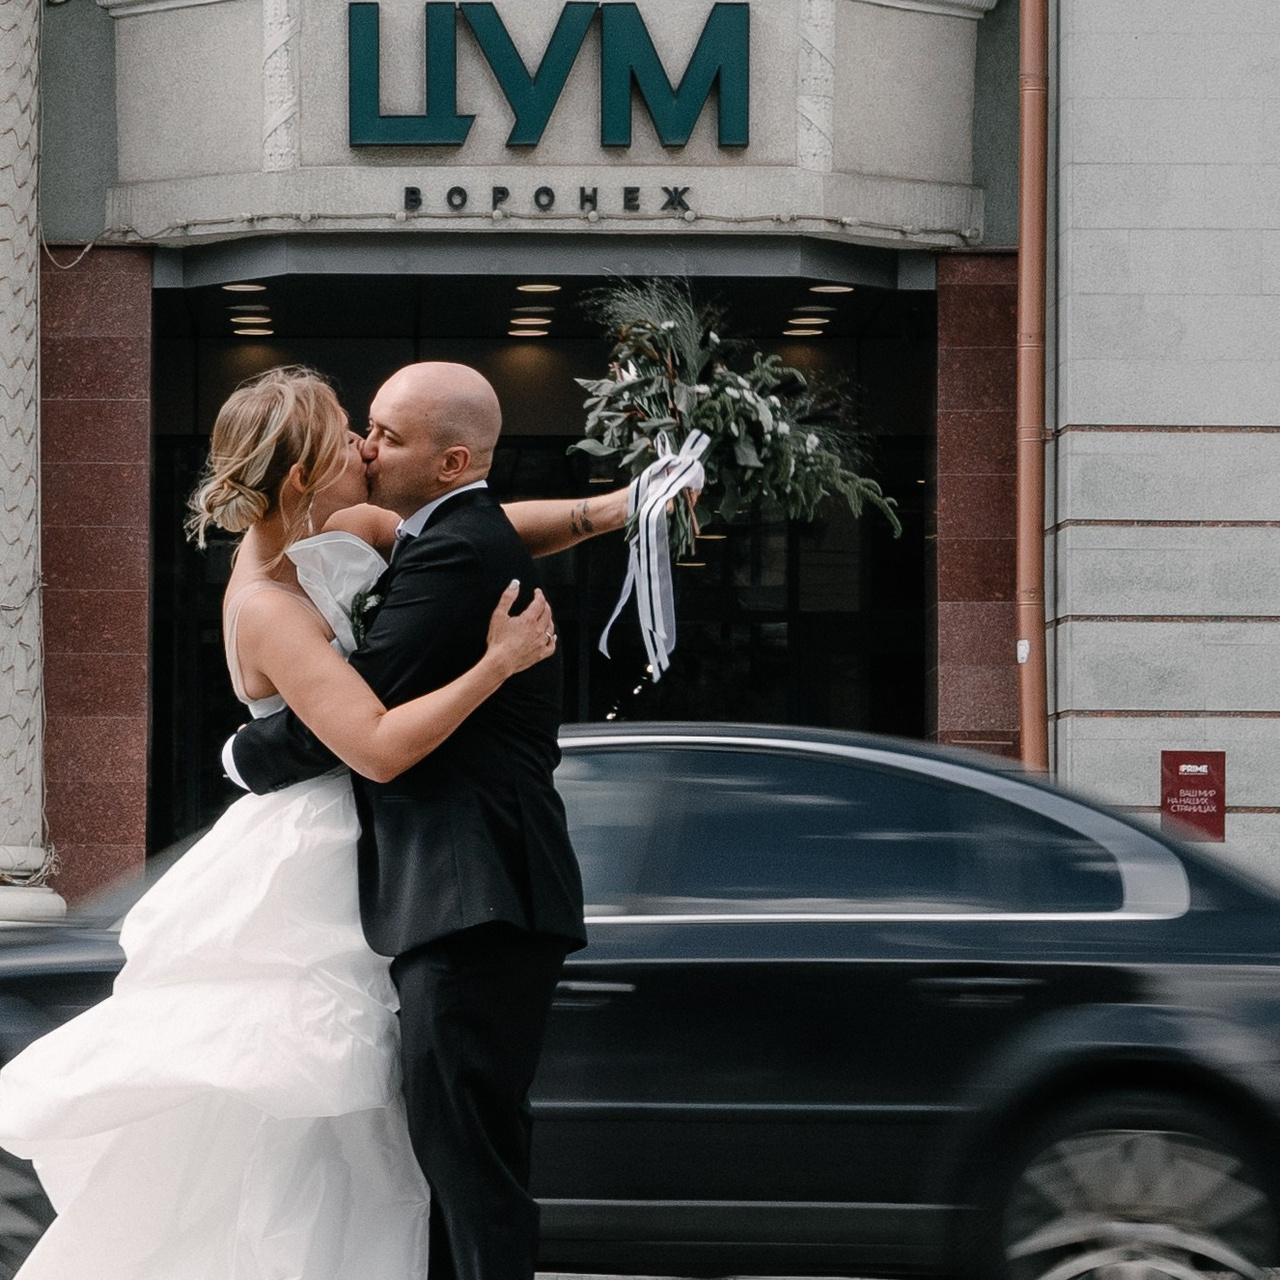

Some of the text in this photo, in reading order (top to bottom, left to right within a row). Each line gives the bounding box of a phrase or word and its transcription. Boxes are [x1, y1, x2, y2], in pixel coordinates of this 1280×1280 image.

[349, 1, 750, 148] ЦУМ
[404, 186, 691, 211] ВОРОНЕЖ
[1179, 789, 1198, 797] ВАШ
